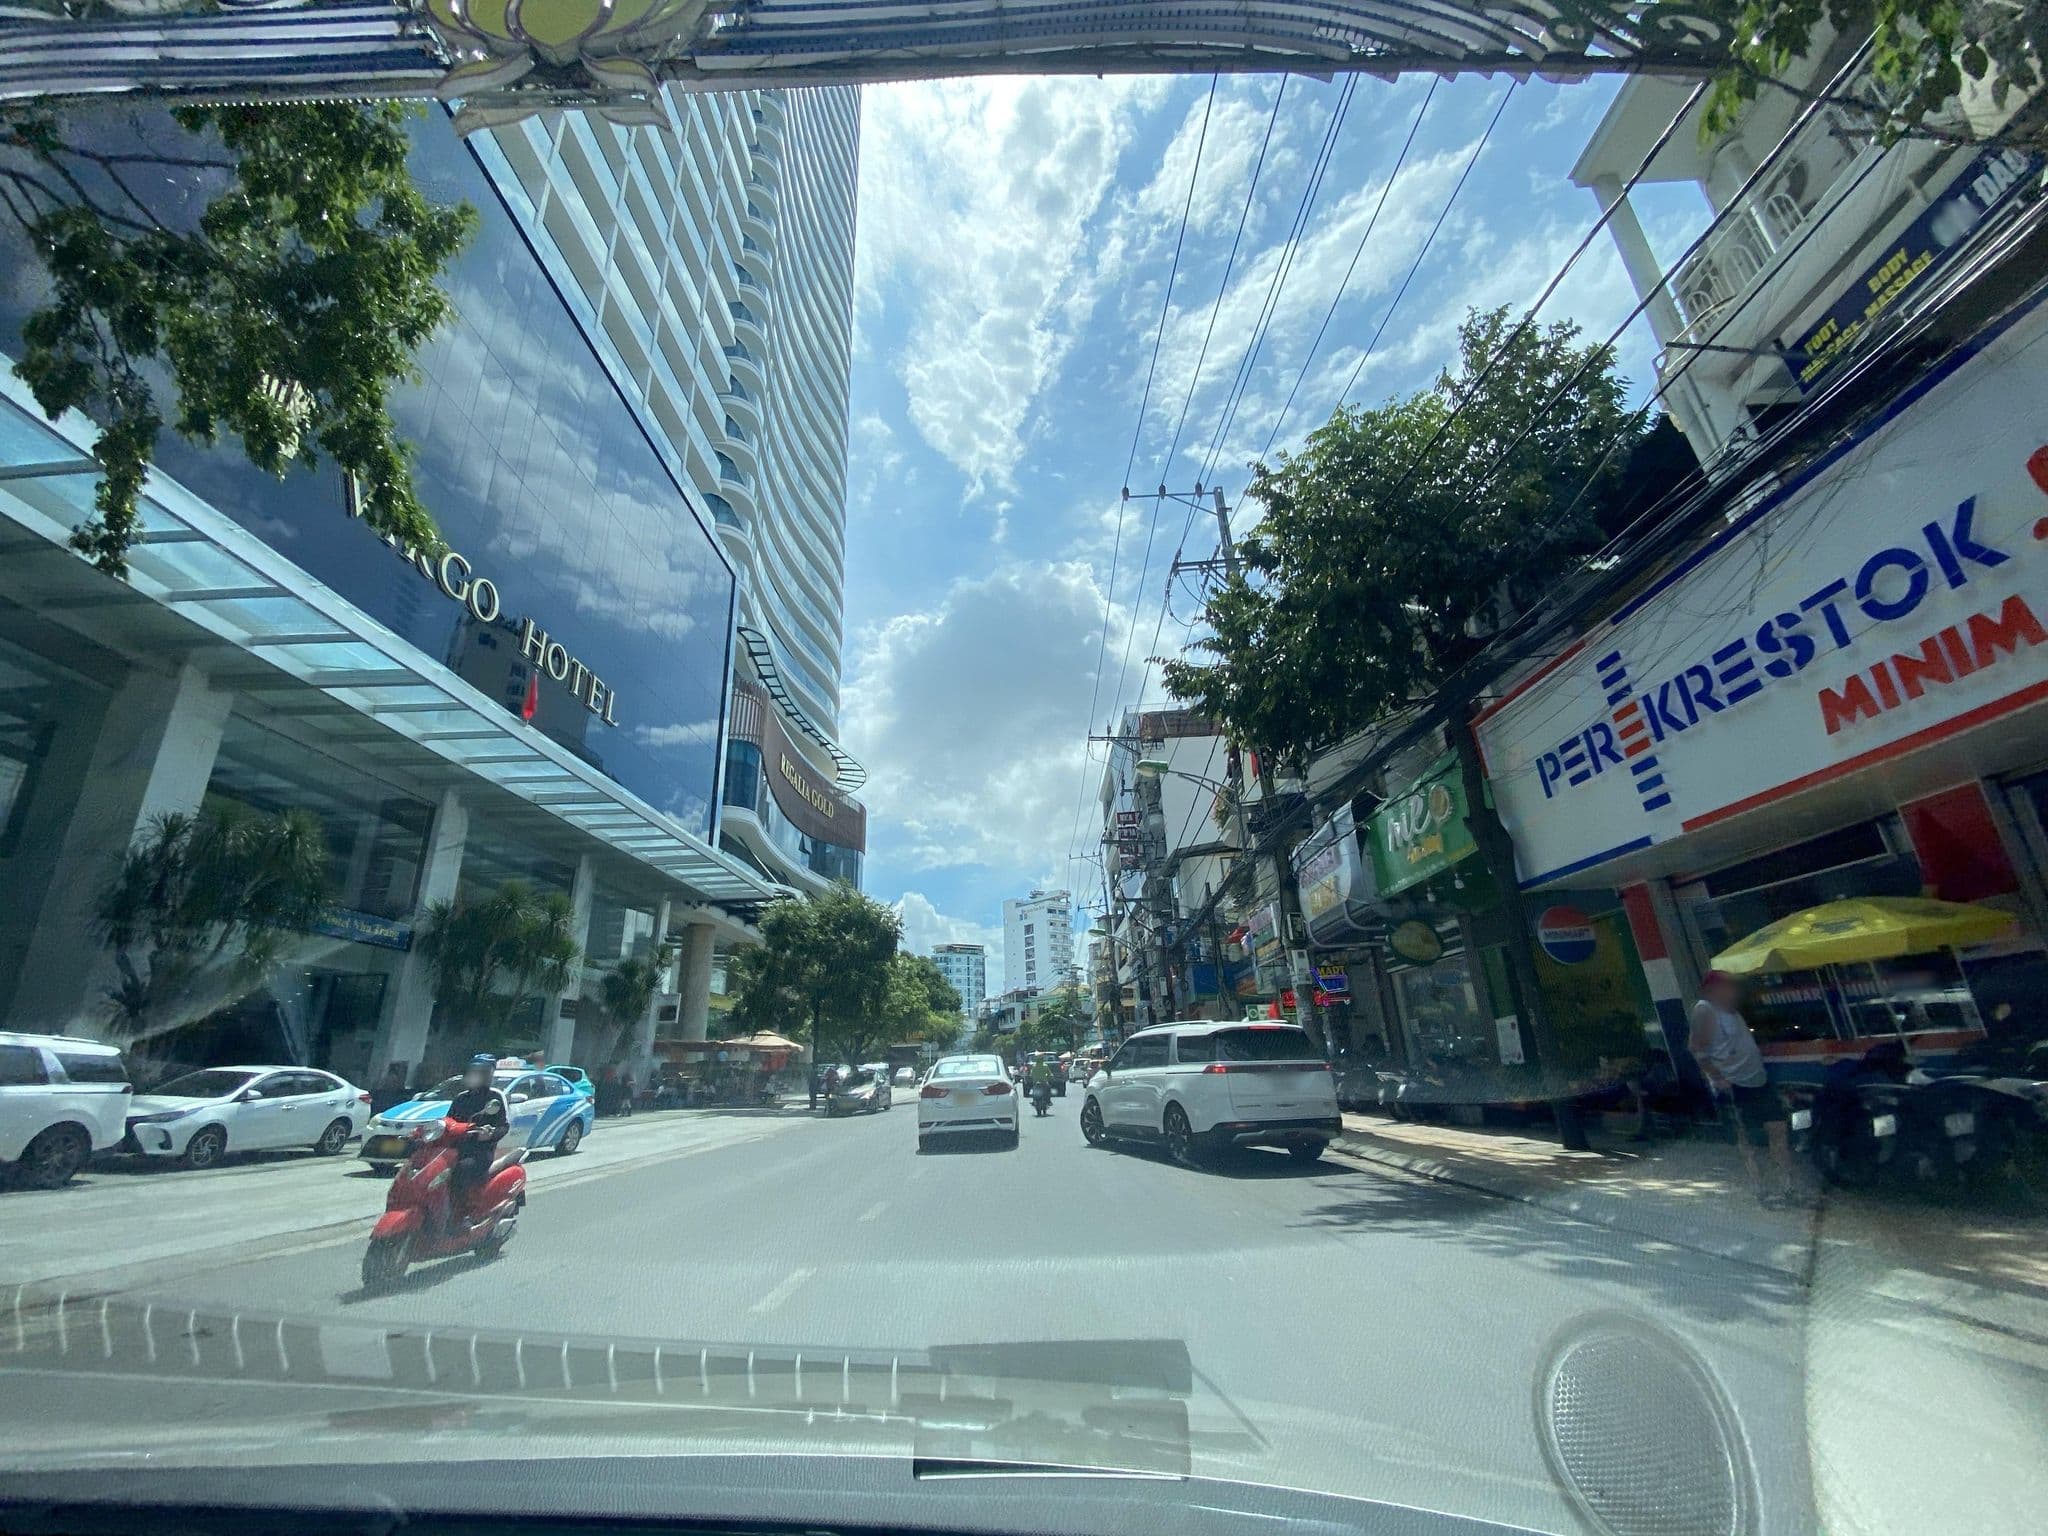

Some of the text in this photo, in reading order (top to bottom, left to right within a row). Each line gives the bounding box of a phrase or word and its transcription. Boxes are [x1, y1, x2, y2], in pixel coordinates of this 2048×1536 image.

[1862, 248, 1935, 321] MASSAGE
[1866, 247, 1909, 294] BODY
[1803, 317, 1839, 357] FOOT
[519, 616, 620, 728] HOTEL
[1536, 494, 2011, 801] PEREKRESTOK
[780, 752, 835, 819] REGALIA GOLD
